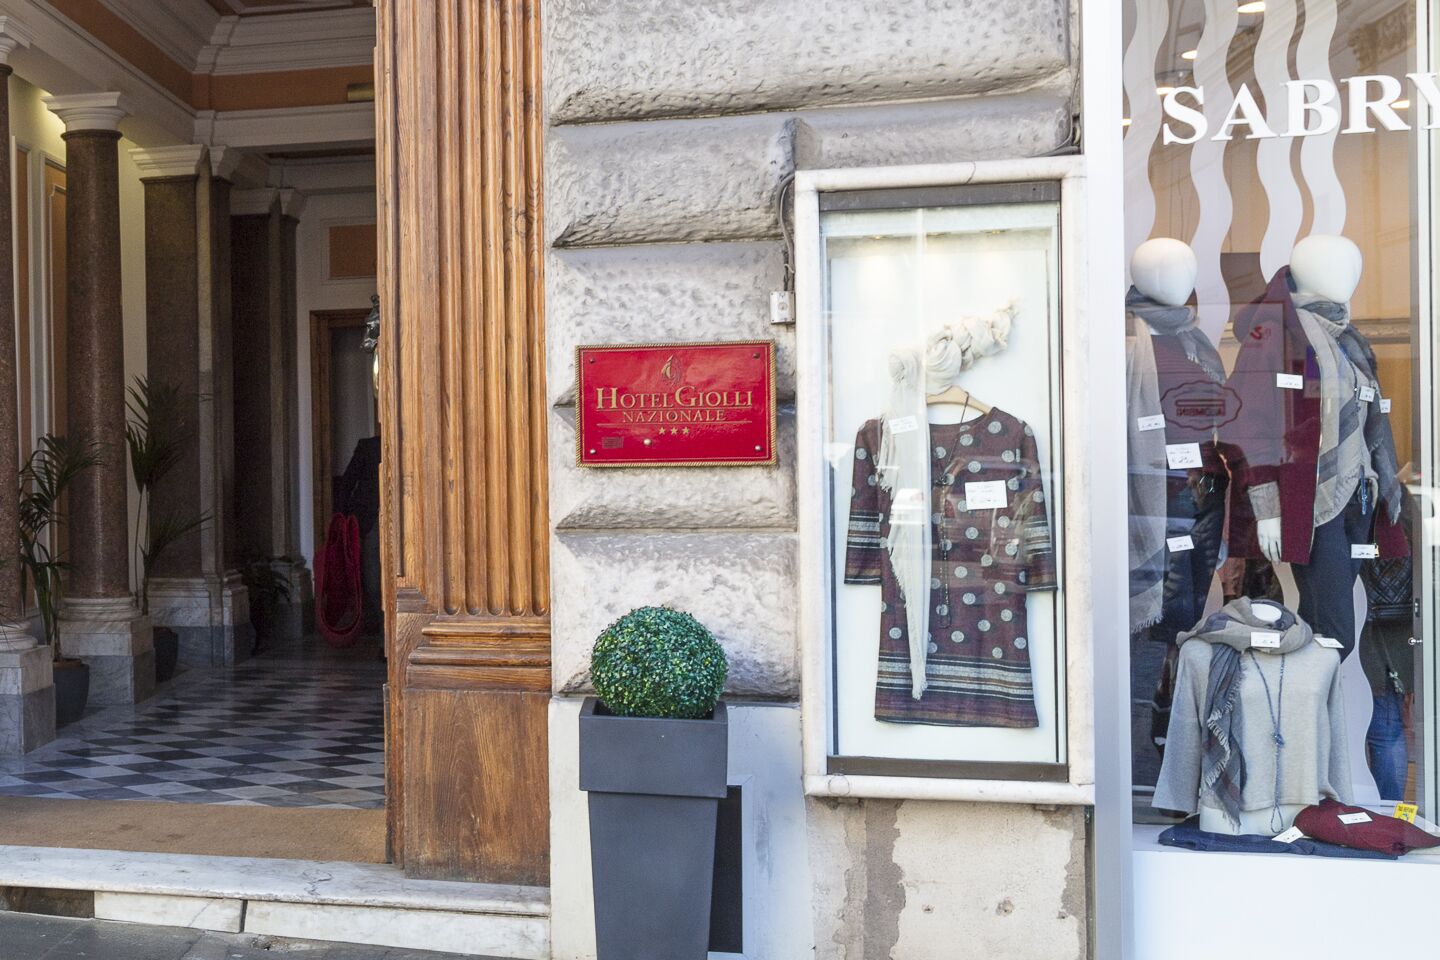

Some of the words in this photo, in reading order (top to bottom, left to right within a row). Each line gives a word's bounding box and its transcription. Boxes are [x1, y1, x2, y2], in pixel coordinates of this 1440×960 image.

[596, 387, 673, 410] HOTEL
[674, 385, 753, 408] GIOLLI
[622, 409, 726, 424] NAZIONALE
